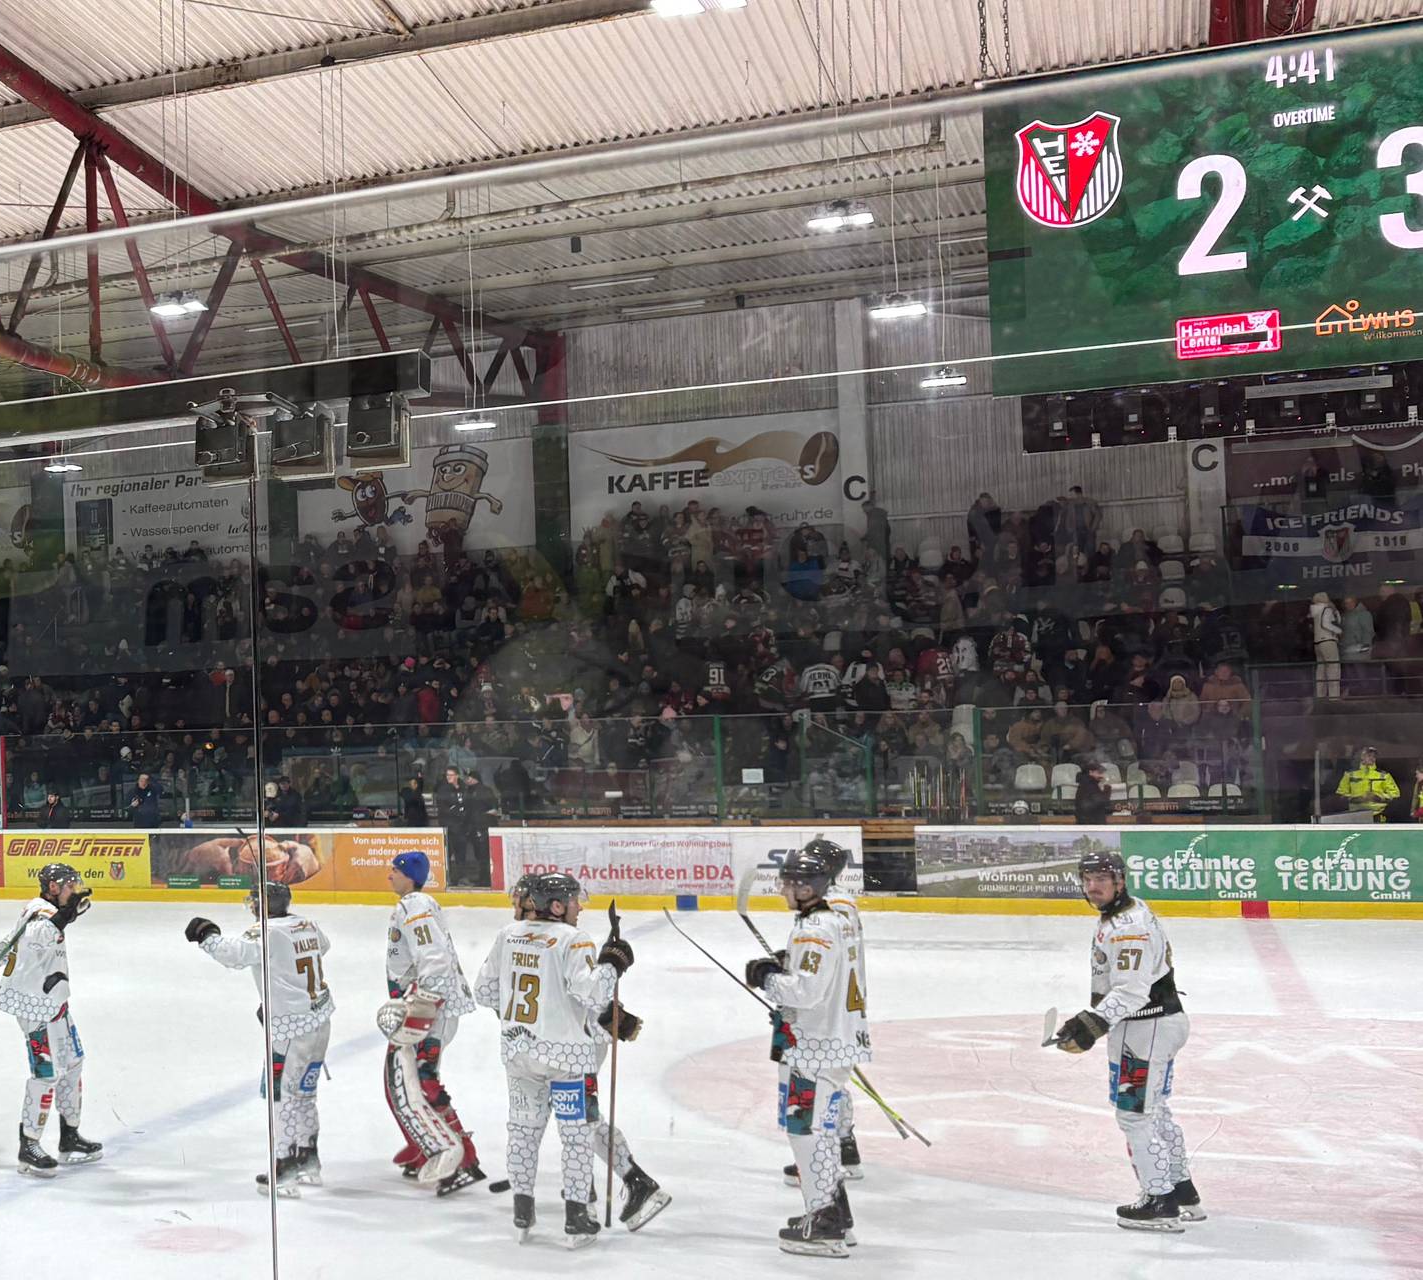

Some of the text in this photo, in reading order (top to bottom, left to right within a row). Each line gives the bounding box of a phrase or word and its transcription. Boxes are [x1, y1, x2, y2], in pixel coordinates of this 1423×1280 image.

[1265, 48, 1335, 88] 4:41
[1273, 105, 1336, 128] OVERTIME
[1376, 126, 1423, 250] 3
[1176, 154, 1248, 276] 2
[1191, 443, 1220, 472] C
[94, 476, 171, 499] regionaler
[607, 468, 710, 495] KAFFEE
[843, 475, 867, 501] C
[129, 497, 229, 515] Kaffeeautomaten
[1310, 503, 1405, 527] FRIENDS
[129, 521, 220, 538] Wasserspender
[1302, 562, 1374, 579] HERNE
[352, 836, 369, 845] Von
[388, 836, 420, 845] können
[421, 836, 440, 845] sich
[90, 846, 143, 857] REISEN
[368, 847, 397, 856] andere
[350, 857, 384, 867] Scheibe
[1127, 853, 1257, 871] Getränke
[1274, 853, 1410, 871] Getränke
[84, 867, 105, 879] den
[578, 863, 691, 881] Architekten
[693, 864, 735, 881] BDA
[977, 871, 1059, 883] Wohnen am
[1129, 871, 1257, 891] TERJUNG
[1278, 871, 1412, 891] TERJUNG
[1218, 890, 1257, 899] GmbH
[1370, 890, 1412, 900] GmbH
[413, 924, 434, 947] 31
[511, 951, 541, 970] FRICK
[1116, 948, 1143, 971] 57
[503, 972, 541, 1025] 13
